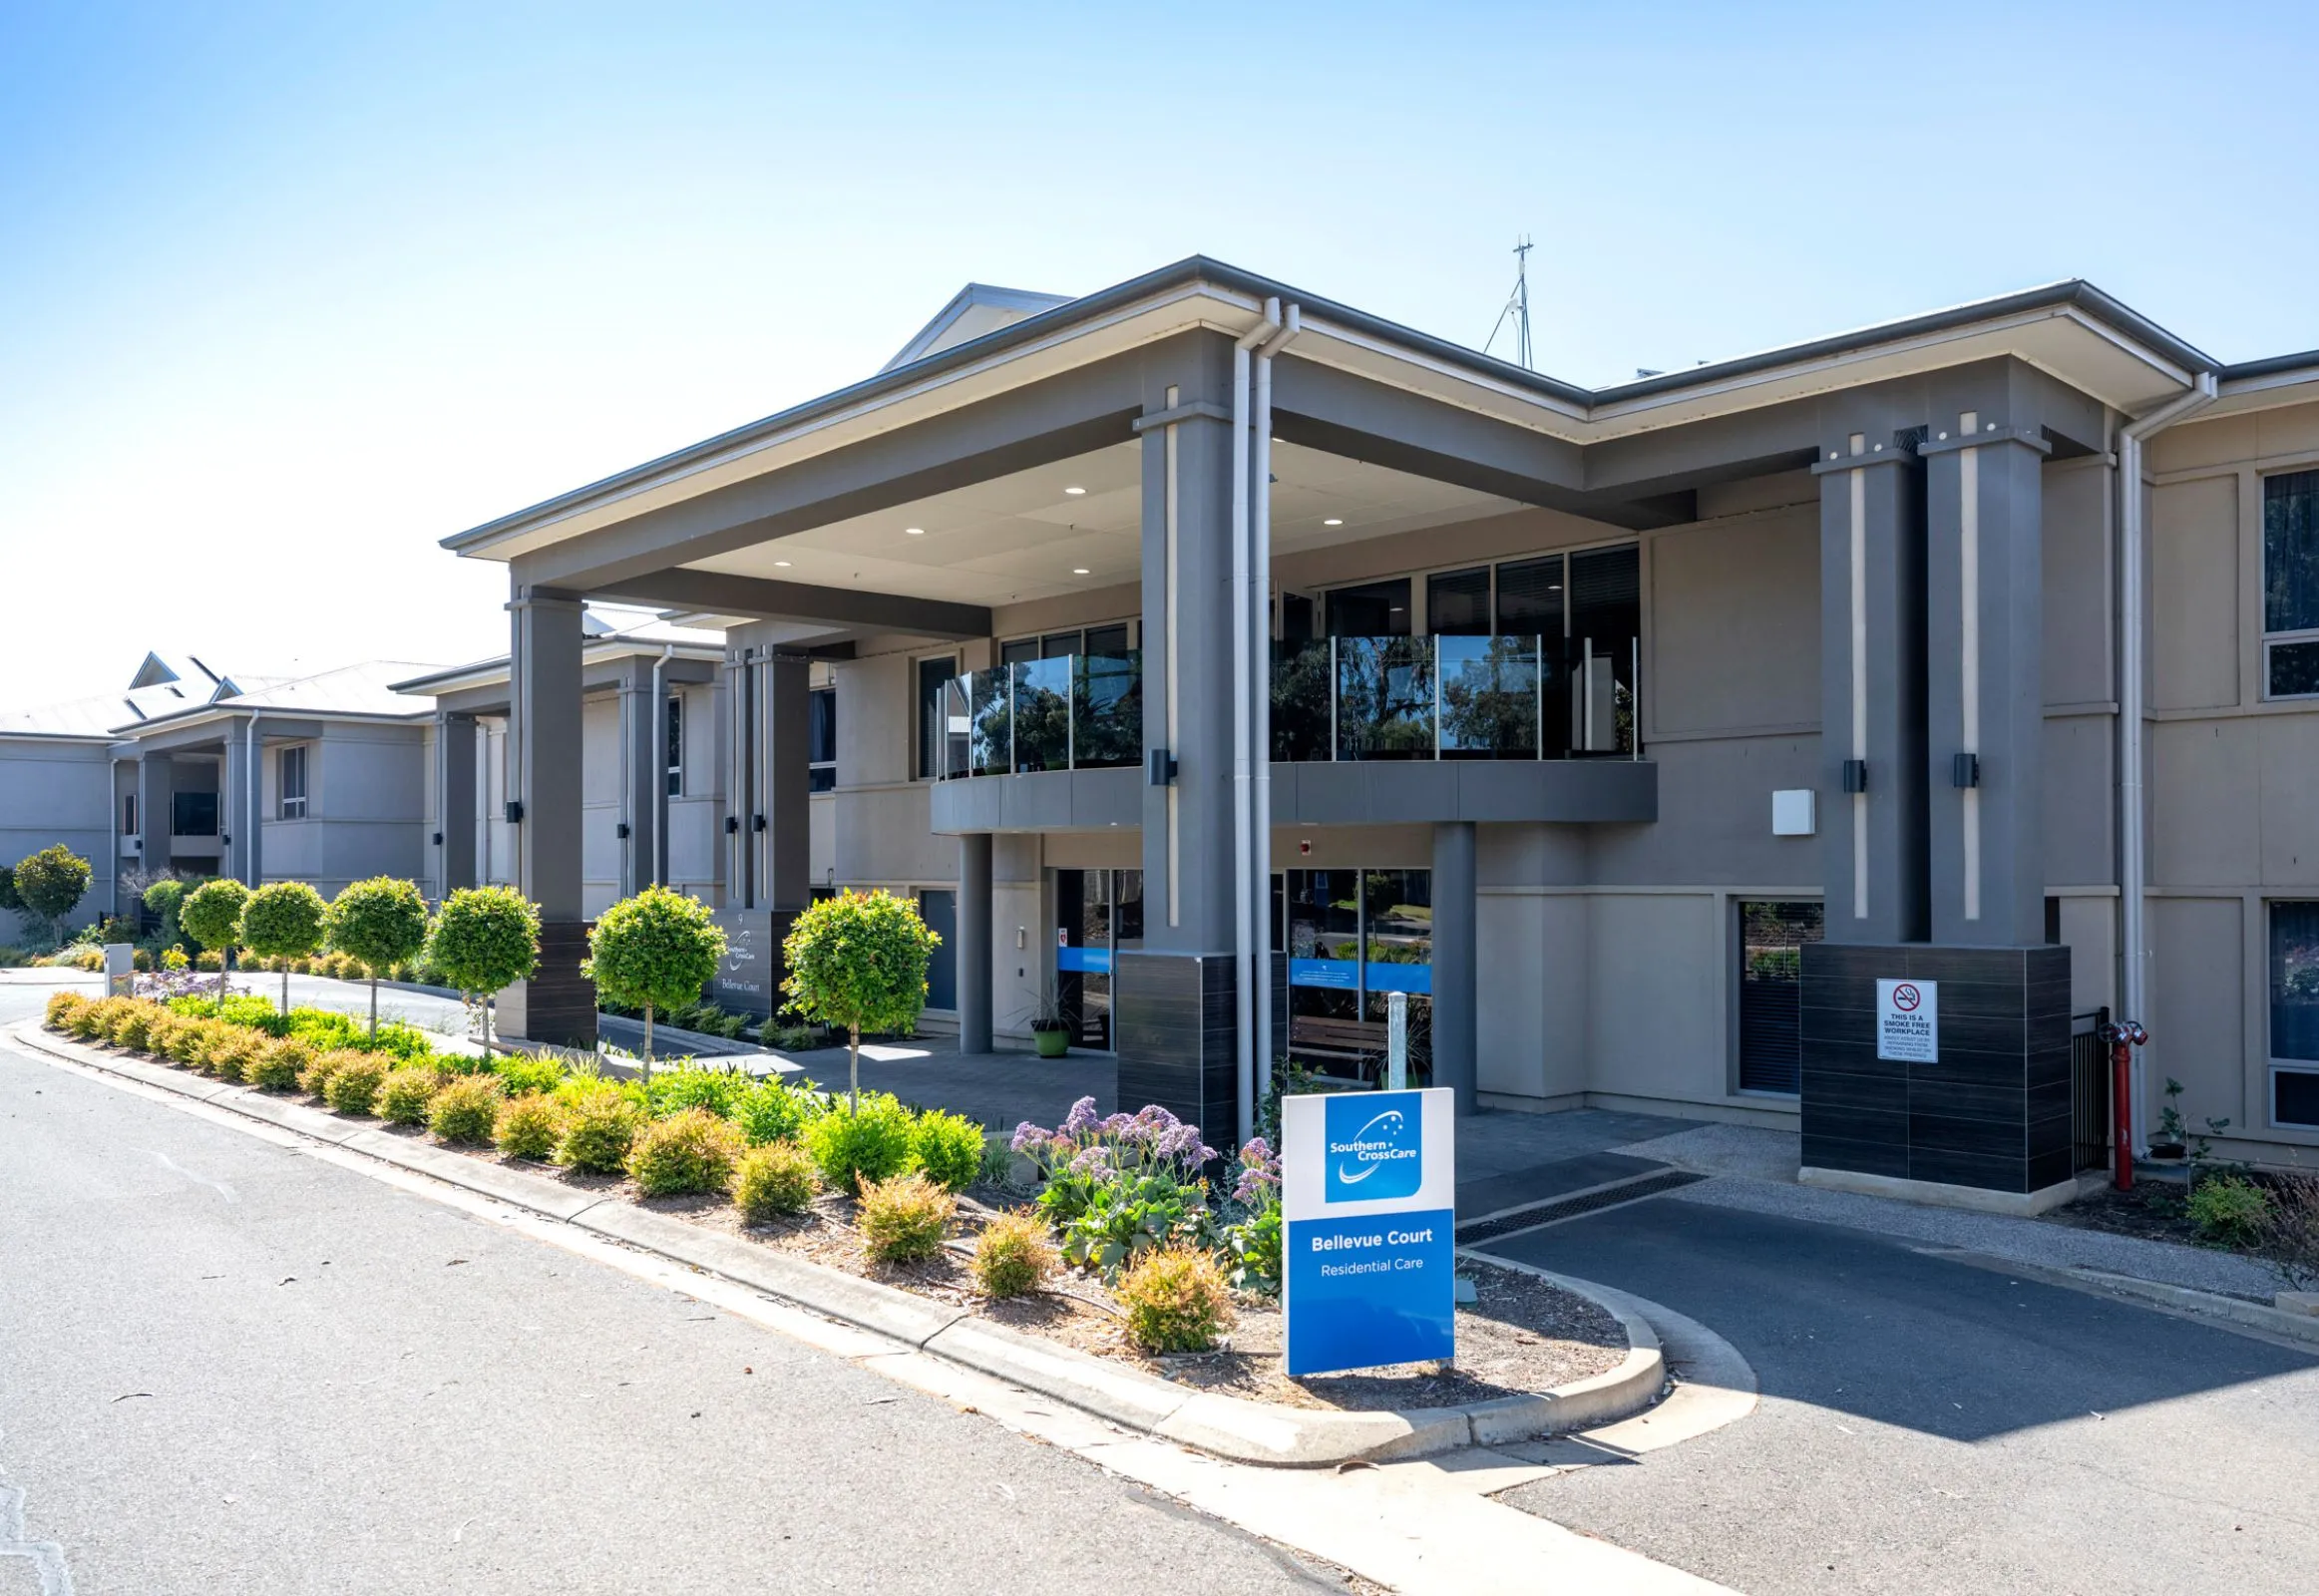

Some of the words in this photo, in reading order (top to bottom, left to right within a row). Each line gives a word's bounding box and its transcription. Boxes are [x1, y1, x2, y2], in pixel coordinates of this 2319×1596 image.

[722, 979, 743, 991] Bellevue
[744, 981, 760, 992] Court
[1331, 1140, 1386, 1153] Southern
[1312, 1234, 1382, 1252] Bellevue
[1387, 1228, 1433, 1245] Court
[1321, 1260, 1390, 1277] Residential
[1394, 1258, 1423, 1270] Care
